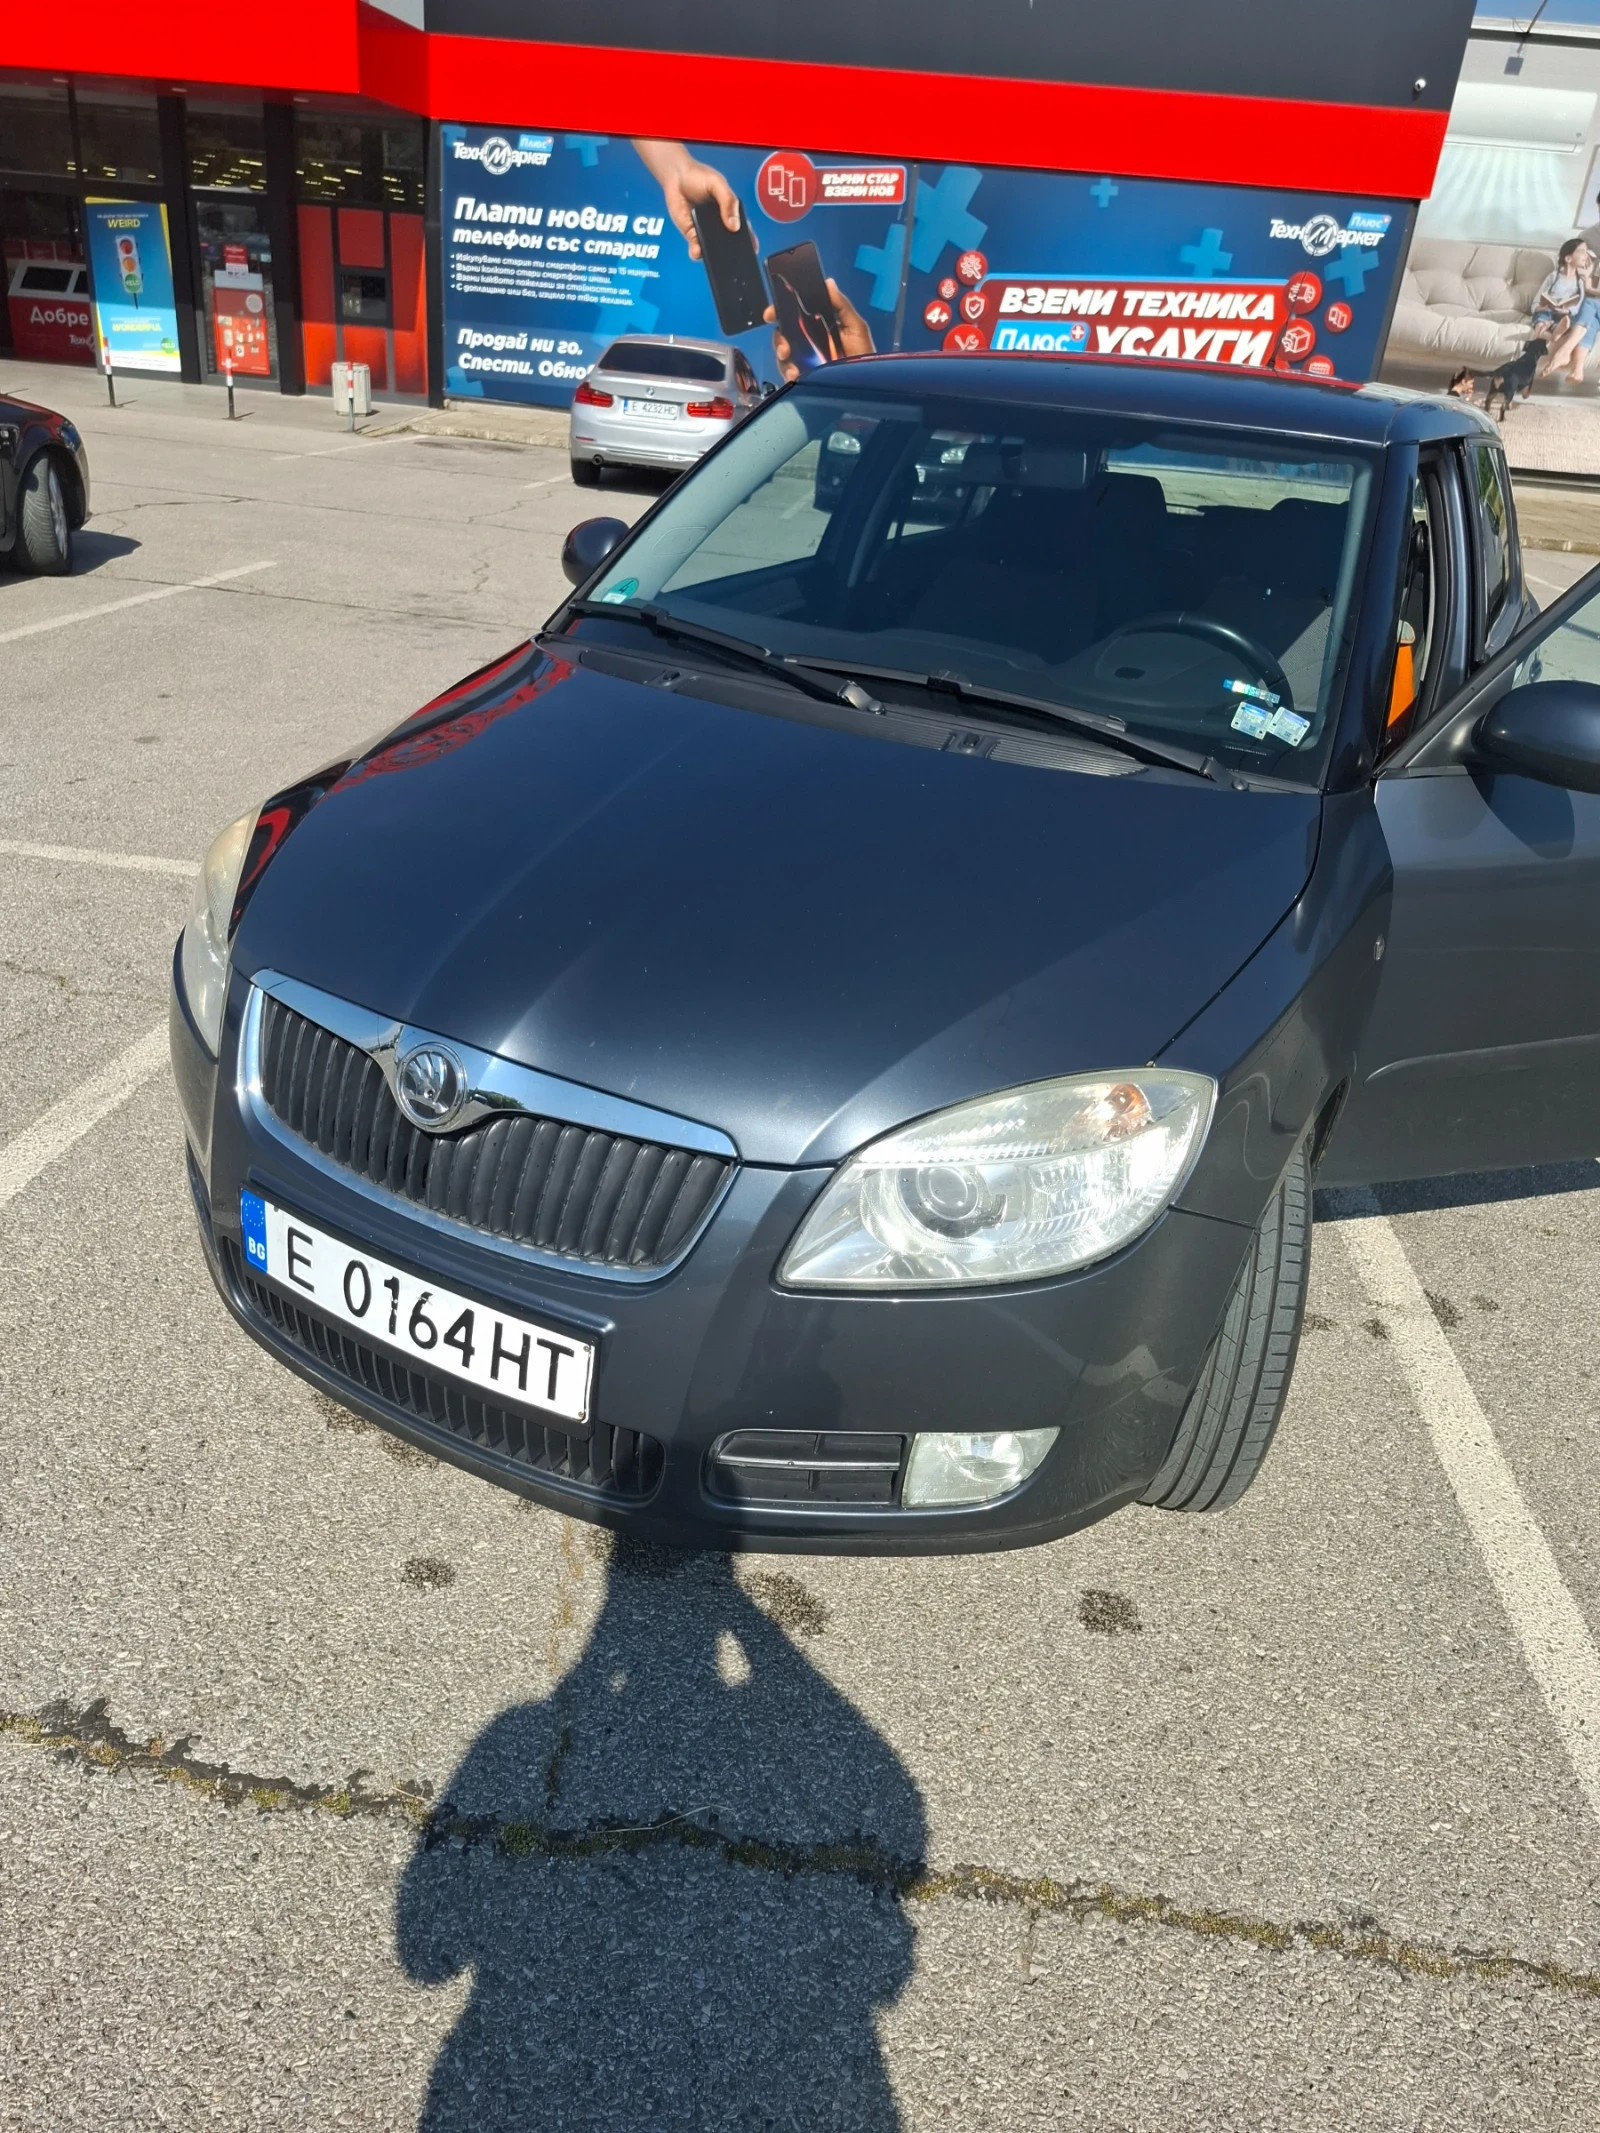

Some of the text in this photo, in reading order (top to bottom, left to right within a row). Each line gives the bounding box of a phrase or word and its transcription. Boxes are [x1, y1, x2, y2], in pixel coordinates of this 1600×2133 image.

[822, 172, 899, 185] ВЪРНИ СТАР
[824, 185, 896, 197] ВЗЕМИ НОВ
[107, 219, 141, 228] WEIRD
[454, 197, 664, 236] Плати новия си
[1350, 216, 1383, 228] Плюс
[453, 228, 660, 260] телефон със стария
[502, 258, 532, 267] стария
[546, 262, 587, 271] смартфон
[999, 287, 1275, 321] ВЗЕМИ ТЕХНИКА
[31, 305, 89, 327] Добре
[457, 328, 583, 356] Продай ни го.
[998, 325, 1273, 367] Плюс УСЛУГИ
[458, 353, 533, 375] Спести.
[248, 1236, 266, 1261] BG
[287, 1226, 315, 1294] E
